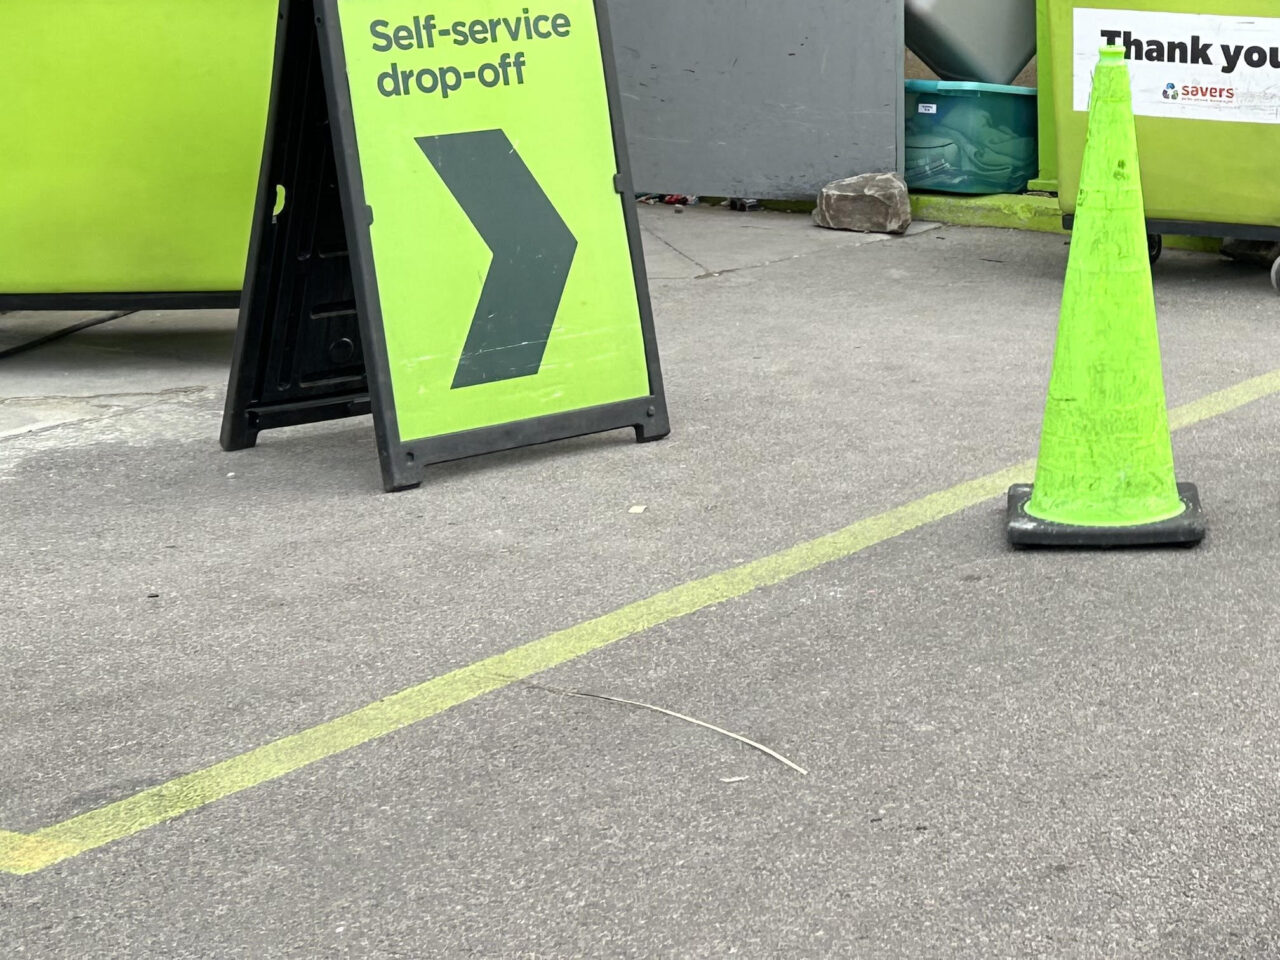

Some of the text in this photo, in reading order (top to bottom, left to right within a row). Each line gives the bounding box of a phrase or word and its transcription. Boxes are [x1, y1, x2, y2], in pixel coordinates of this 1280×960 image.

[370, 7, 571, 52] Self-service
[1100, 30, 1214, 65] Thank
[377, 52, 526, 98] drop-off
[1181, 84, 1234, 99] savers
